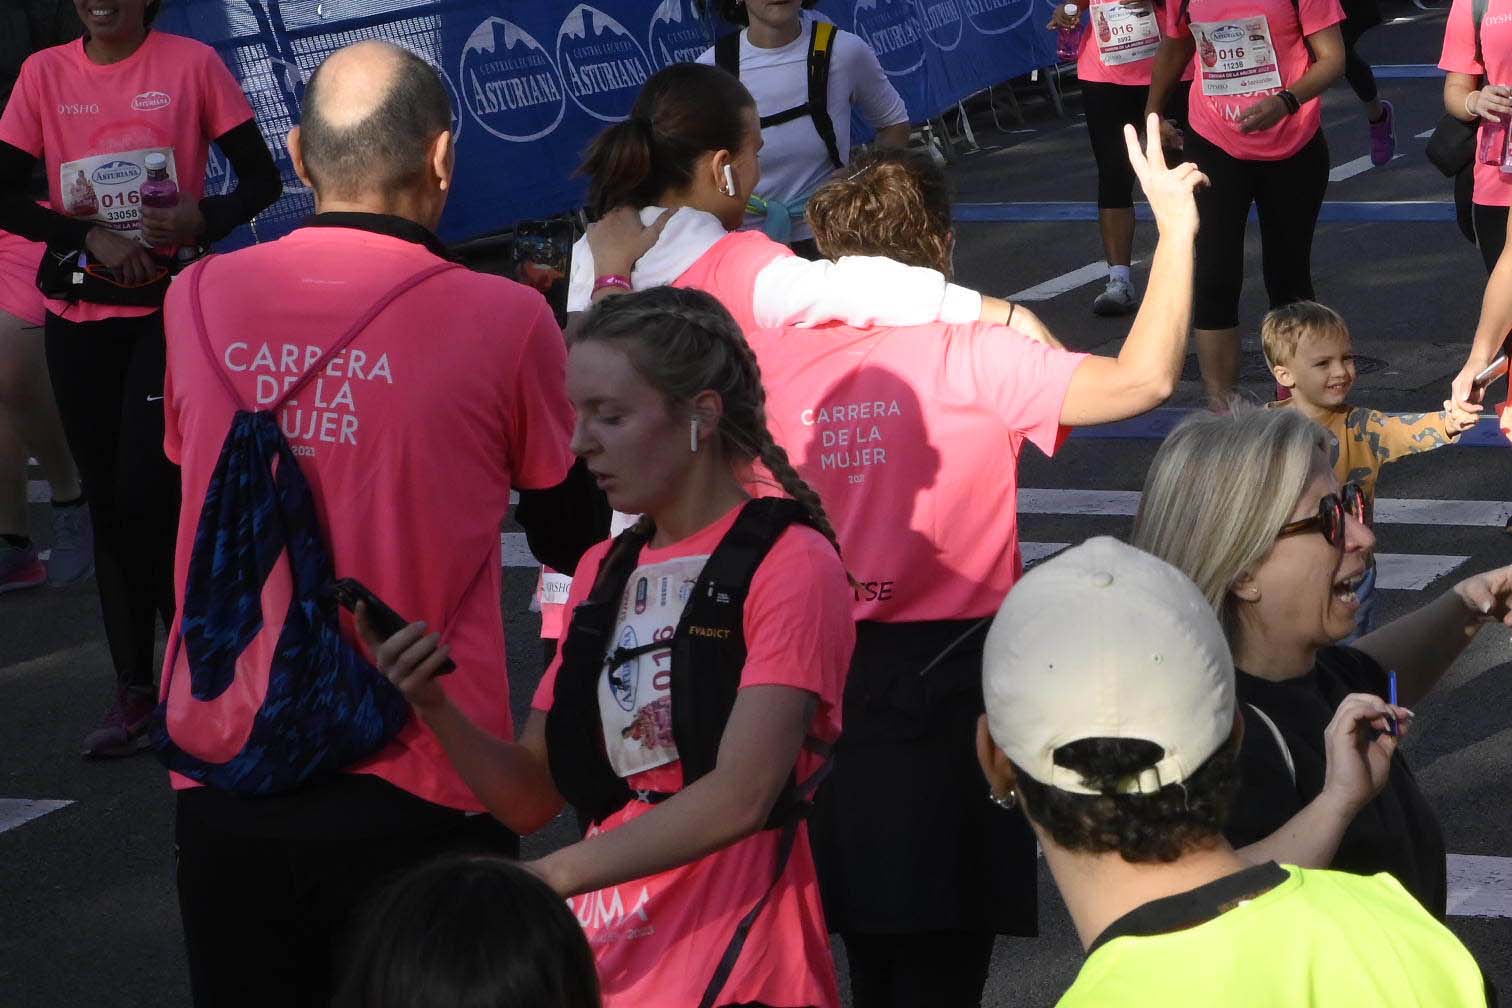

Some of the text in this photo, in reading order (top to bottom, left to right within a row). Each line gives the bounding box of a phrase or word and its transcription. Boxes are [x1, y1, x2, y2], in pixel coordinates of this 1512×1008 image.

[1111, 23, 1134, 37] 016
[1218, 46, 1245, 61] 016
[565, 52, 648, 97] ASTURIANA
[470, 68, 562, 115] ASTURIANA
[96, 168, 139, 182] ASTURIANA
[101, 190, 141, 209] 016
[107, 209, 138, 221] 33058
[223, 340, 394, 385] CARRERA
[314, 379, 357, 413] LA
[800, 398, 902, 428] CARRERA
[280, 410, 359, 446] UJER
[822, 426, 882, 448] DE LA
[820, 447, 887, 472] MUJER
[688, 625, 731, 639] EVADICT
